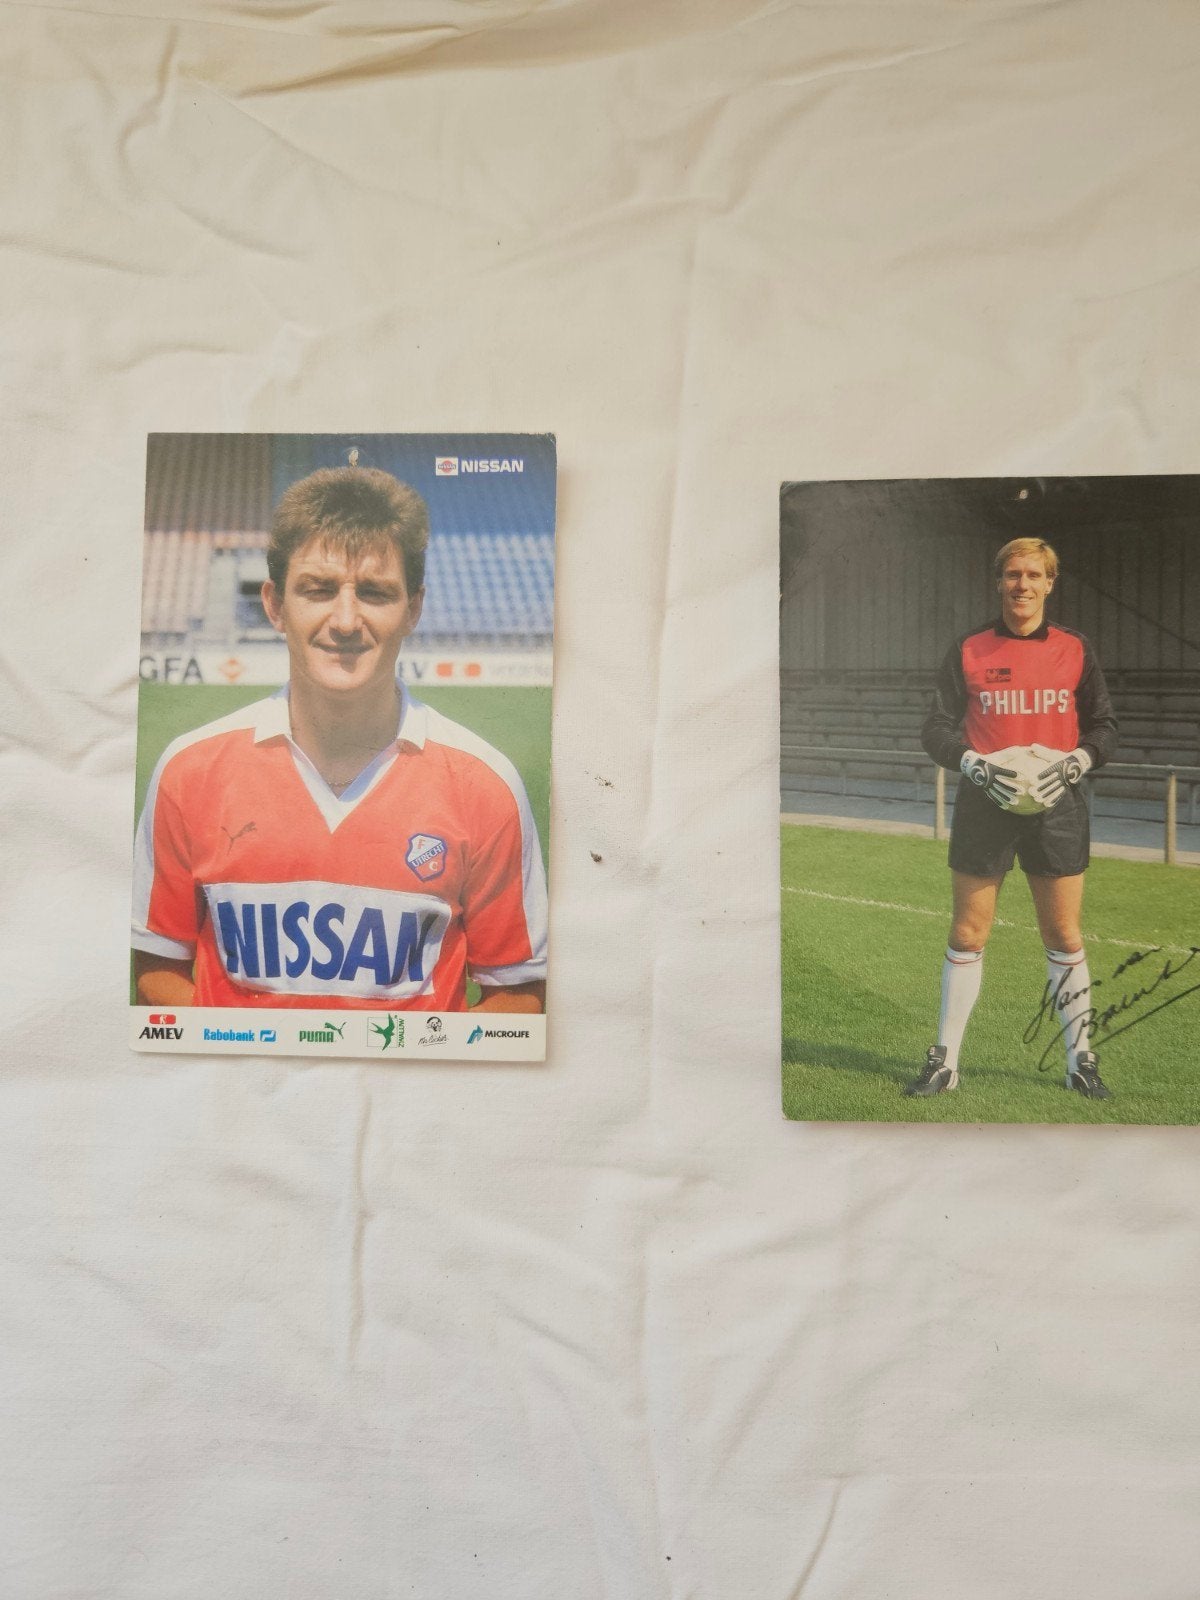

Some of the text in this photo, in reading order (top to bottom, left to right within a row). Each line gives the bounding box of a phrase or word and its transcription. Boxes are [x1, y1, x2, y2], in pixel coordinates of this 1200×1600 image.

[461, 459, 524, 473] NISSAN
[979, 688, 1069, 715] PHILIPS
[409, 840, 444, 867] UTRECHT
[217, 901, 440, 986] NISSAN
[138, 1026, 184, 1040] AMEV
[203, 1028, 255, 1042] Rabobank
[484, 1029, 530, 1039] MICROLIFE
